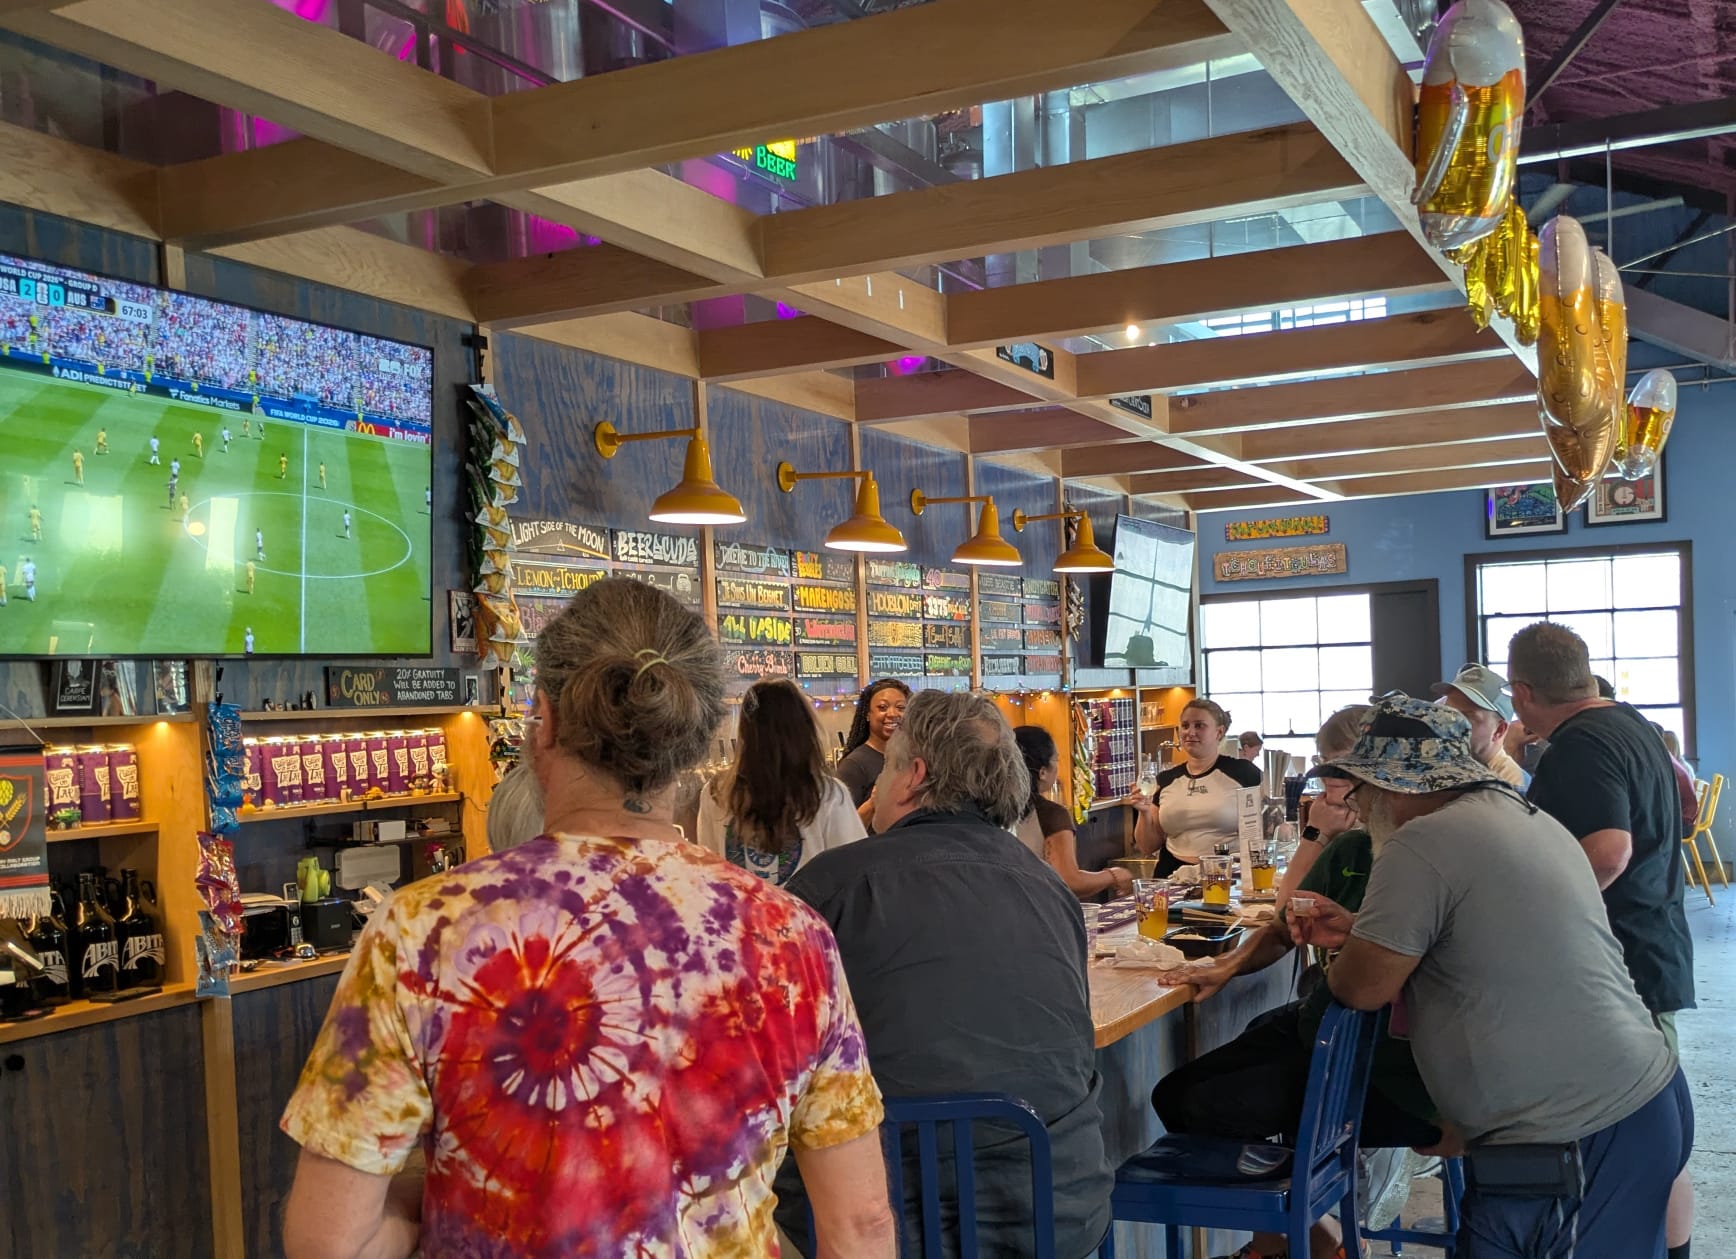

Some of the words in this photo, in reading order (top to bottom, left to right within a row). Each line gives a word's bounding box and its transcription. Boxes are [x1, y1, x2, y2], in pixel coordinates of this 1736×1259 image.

[756, 145, 796, 181] BEER
[0, 266, 27, 277] WORLD
[28, 271, 42, 281] CUP
[68, 280, 91, 291] GROUP
[24, 284, 32, 296] 2
[53, 290, 60, 301] 0
[67, 291, 87, 306] AUS
[122, 305, 148, 318] 67:03
[61, 368, 83, 381] ADI
[404, 363, 423, 378] FOX
[179, 390, 209, 405] Fanatics
[210, 397, 240, 410] Markets
[270, 409, 283, 418] FIFA
[284, 412, 305, 421] WORLD
[306, 415, 318, 423] CUP
[389, 427, 403, 439] i'm
[404, 431, 429, 444] lovin'
[510, 519, 541, 546] LIGHT
[540, 520, 556, 534] SIDE
[555, 521, 564, 530] OF
[563, 522, 578, 538] THE
[578, 527, 605, 553] MOON
[617, 531, 698, 564] BEERACUDA
[748, 550, 757, 566] TO
[749, 616, 792, 641] UPSIDE
[736, 655, 764, 677] Cherry
[396, 669, 411, 680] 20%
[412, 669, 445, 680] GRATUITY
[341, 670, 375, 698] CARD
[393, 681, 409, 689] WILL
[412, 680, 421, 689] BE
[422, 680, 445, 689] ADDED
[446, 681, 456, 689] TO
[354, 690, 380, 705] ONLY
[397, 691, 435, 701] ABANDONED
[436, 691, 454, 700] TABS
